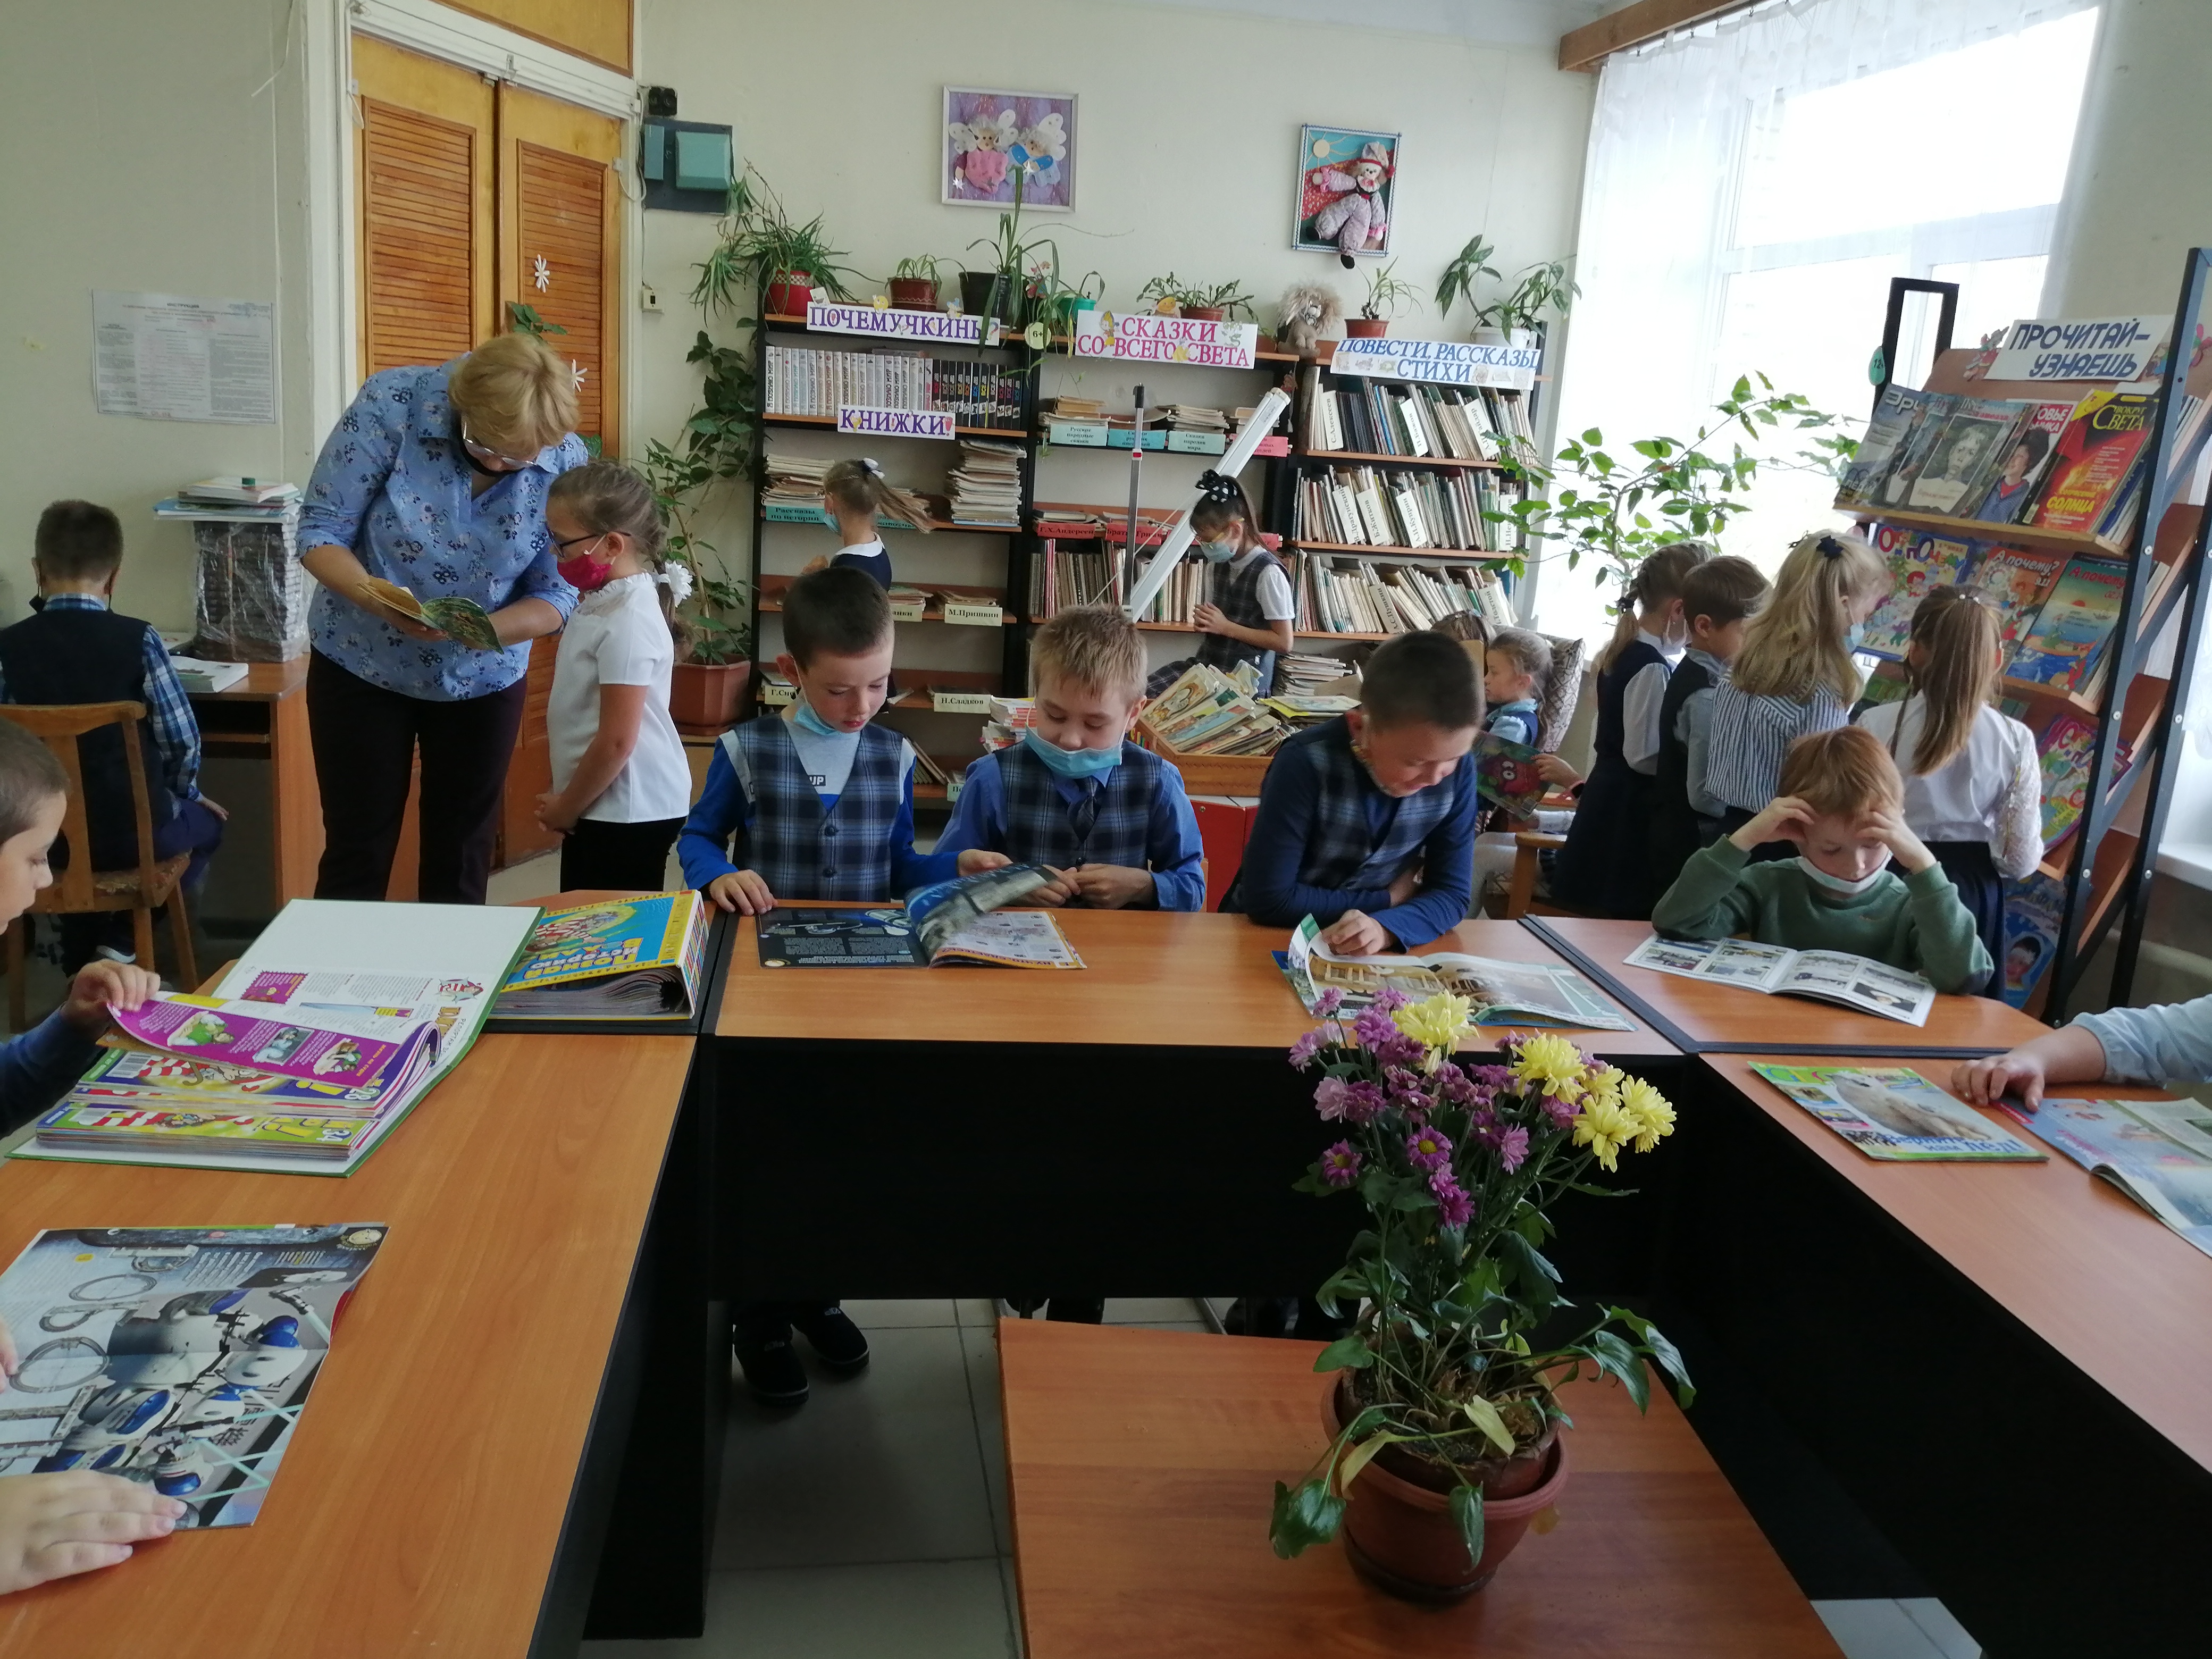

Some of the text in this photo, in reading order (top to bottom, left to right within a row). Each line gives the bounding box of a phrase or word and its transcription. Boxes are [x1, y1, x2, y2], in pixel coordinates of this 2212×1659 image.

[1122, 317, 1218, 343] СКАЗКИ
[2009, 318, 2151, 350] ПРОЧИТАЙ-
[1078, 335, 1250, 367] СО ВСЕГО СВЕТА
[1338, 339, 1431, 360] ПОВЕСТИ,
[1397, 359, 1472, 383] СТИХИ
[2029, 353, 2138, 378] УЗНАЕШЬ
[840, 409, 946, 436] КНИЖКИ
[2092, 405, 2145, 431] СВЕТА
[2047, 496, 2096, 514] СОЛНЦА
[1365, 500, 1380, 538] Б.Житков
[1993, 550, 2060, 576] А почему?
[949, 609, 999, 618] М.Пришвин
